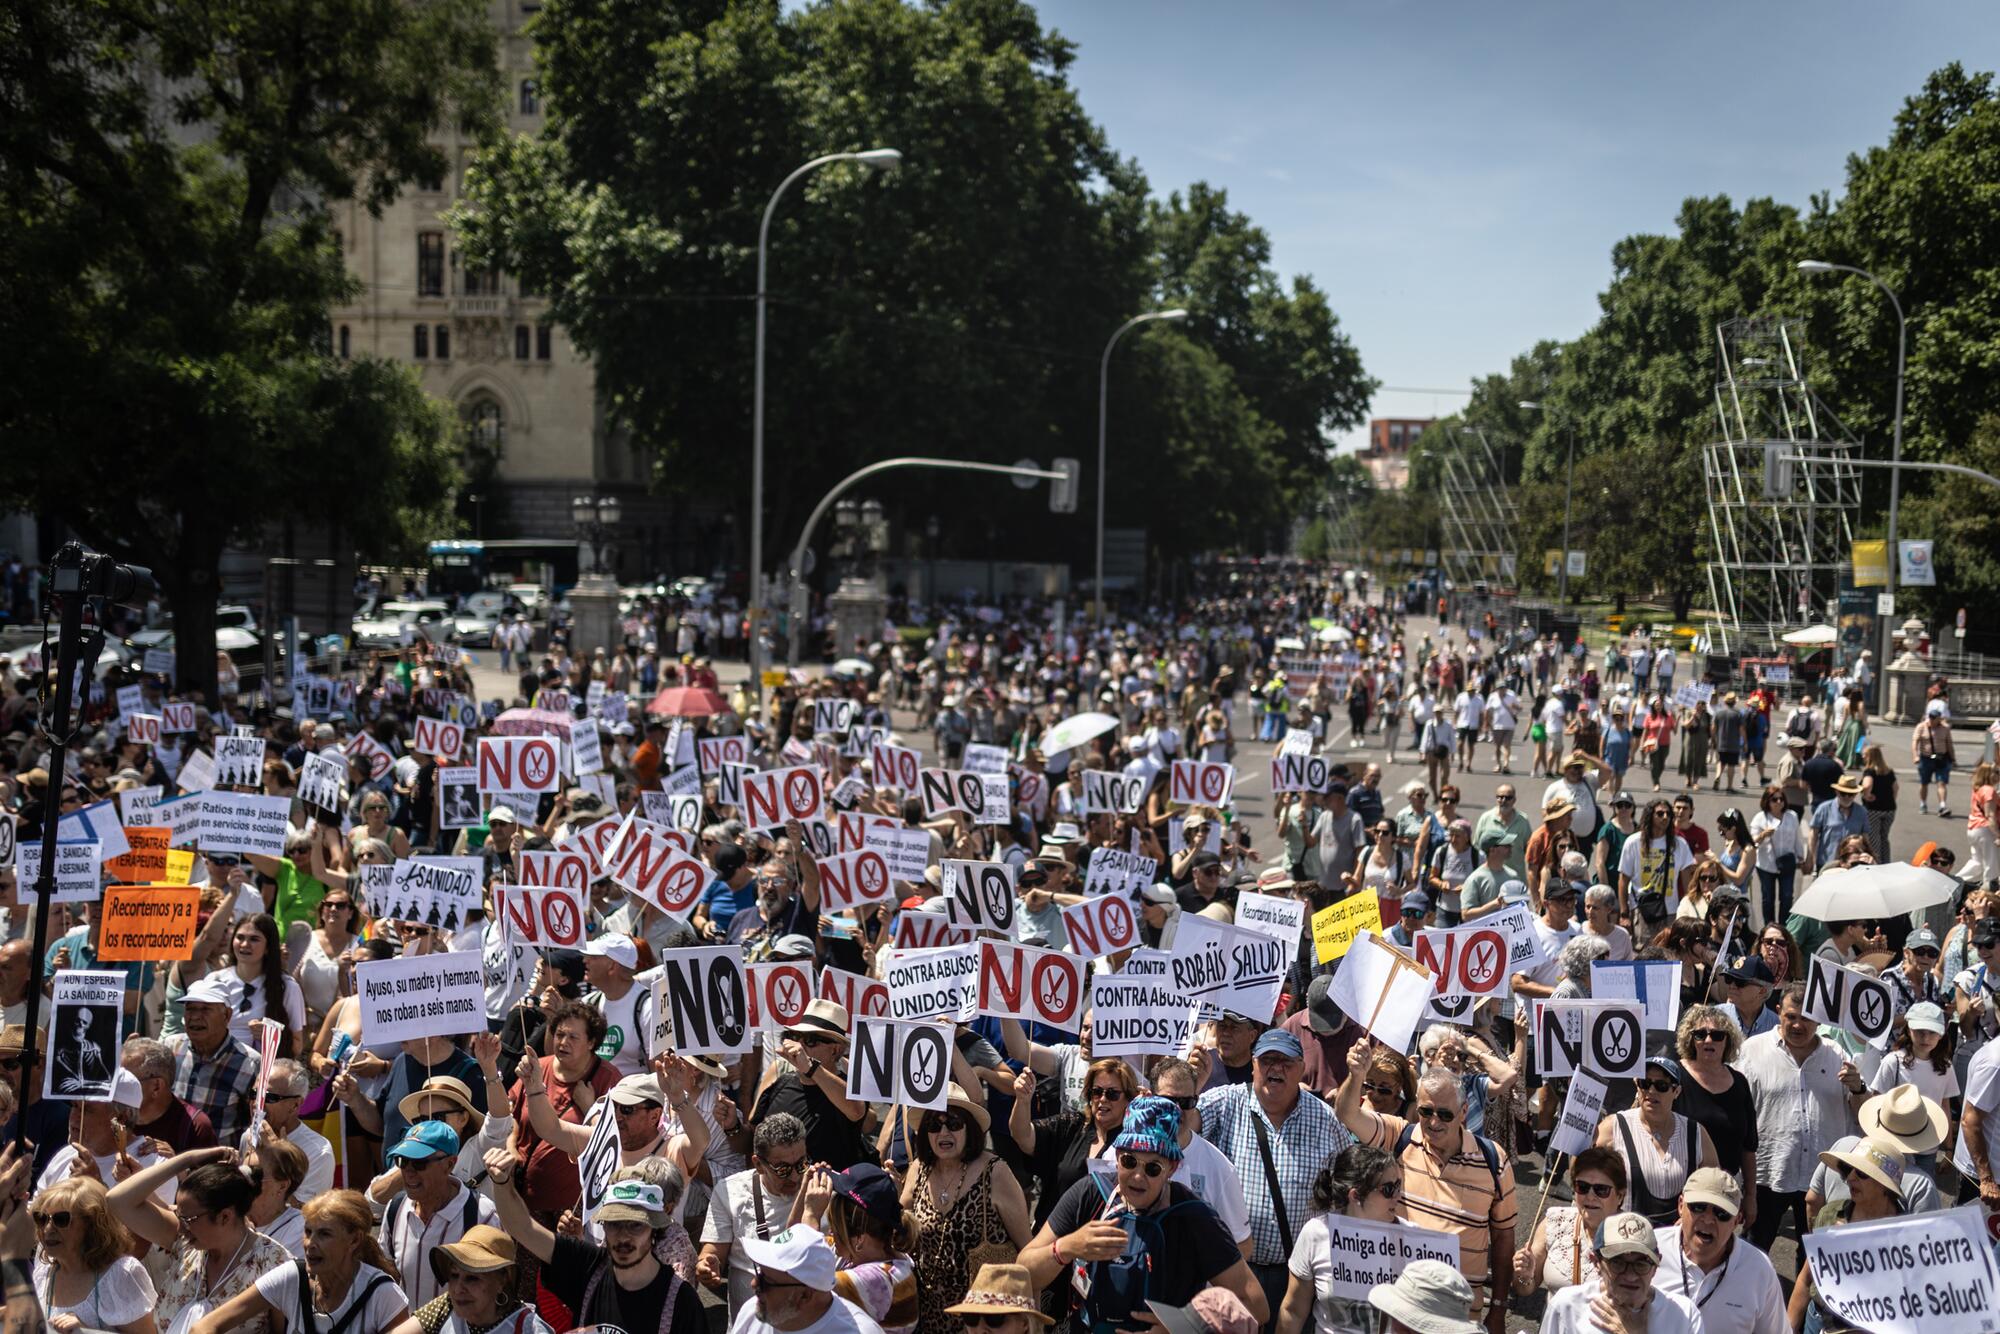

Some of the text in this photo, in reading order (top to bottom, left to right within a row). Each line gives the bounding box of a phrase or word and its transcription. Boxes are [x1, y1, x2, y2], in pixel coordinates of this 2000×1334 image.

[129, 715, 159, 743] NO
[163, 705, 193, 730] NO
[817, 701, 850, 729] NO
[229, 739, 263, 757] SANIDAD
[416, 719, 460, 756] NO
[479, 739, 556, 790] NO
[702, 739, 743, 770] NO
[874, 746, 917, 791] NO
[1285, 753, 1326, 787] NO
[921, 771, 985, 815] NO
[1173, 762, 1226, 803] NO
[202, 802, 288, 821] Ratios más justas
[743, 769, 819, 829] NO
[201, 819, 285, 836] en servicios sociales
[205, 833, 242, 845] residencias
[243, 836, 251, 846] de
[253, 839, 283, 850] mayores.
[905, 842, 928, 852] justas
[522, 855, 587, 897] NO
[616, 832, 705, 912] NO
[819, 851, 888, 908] NO
[1108, 851, 1153, 878] SANDAD
[416, 865, 472, 897] SANIDAD
[942, 863, 1013, 930] NO
[108, 896, 192, 923] ¡Recortemos ya a
[499, 890, 581, 945] NO
[1242, 902, 1298, 928] Recortaron la Sanidad
[105, 927, 189, 948] los recortadores!
[1063, 896, 1133, 956] NO
[1316, 928, 1350, 944] universal
[889, 962, 936, 989] CONTRA
[1127, 959, 1166, 975] CONTR
[1232, 939, 1286, 981] SALUD!
[1416, 930, 1507, 994] NO
[59, 990, 119, 1000] LA SANIDAD PP
[84, 976, 116, 985] ESPERA
[366, 969, 482, 1001] Ayuso, su madre y hermano,
[979, 943, 1079, 1024] NO
[376, 997, 476, 1023] nos roban a seis manos.
[666, 955, 747, 1050] NO
[892, 988, 962, 1018] UNIDOS,
[1096, 986, 1148, 1008] CONTRA
[1806, 960, 1891, 1038] NO
[1096, 1018, 1172, 1044] UNIDOS,
[1543, 1010, 1642, 1073] NO
[851, 1021, 947, 1104] NO
[582, 1093, 619, 1211] NO
[1332, 1228, 1376, 1260] Amiga
[1379, 1236, 1396, 1257] de
[1399, 1238, 1412, 1258] lo
[1811, 1233, 1974, 1287] ¡Ayuso nos cierra
[1333, 1262, 1352, 1281] ella
[1355, 1269, 1374, 1285] nos
[1900, 1286, 1924, 1319] de
[1924, 1277, 1989, 1317] Salud!
